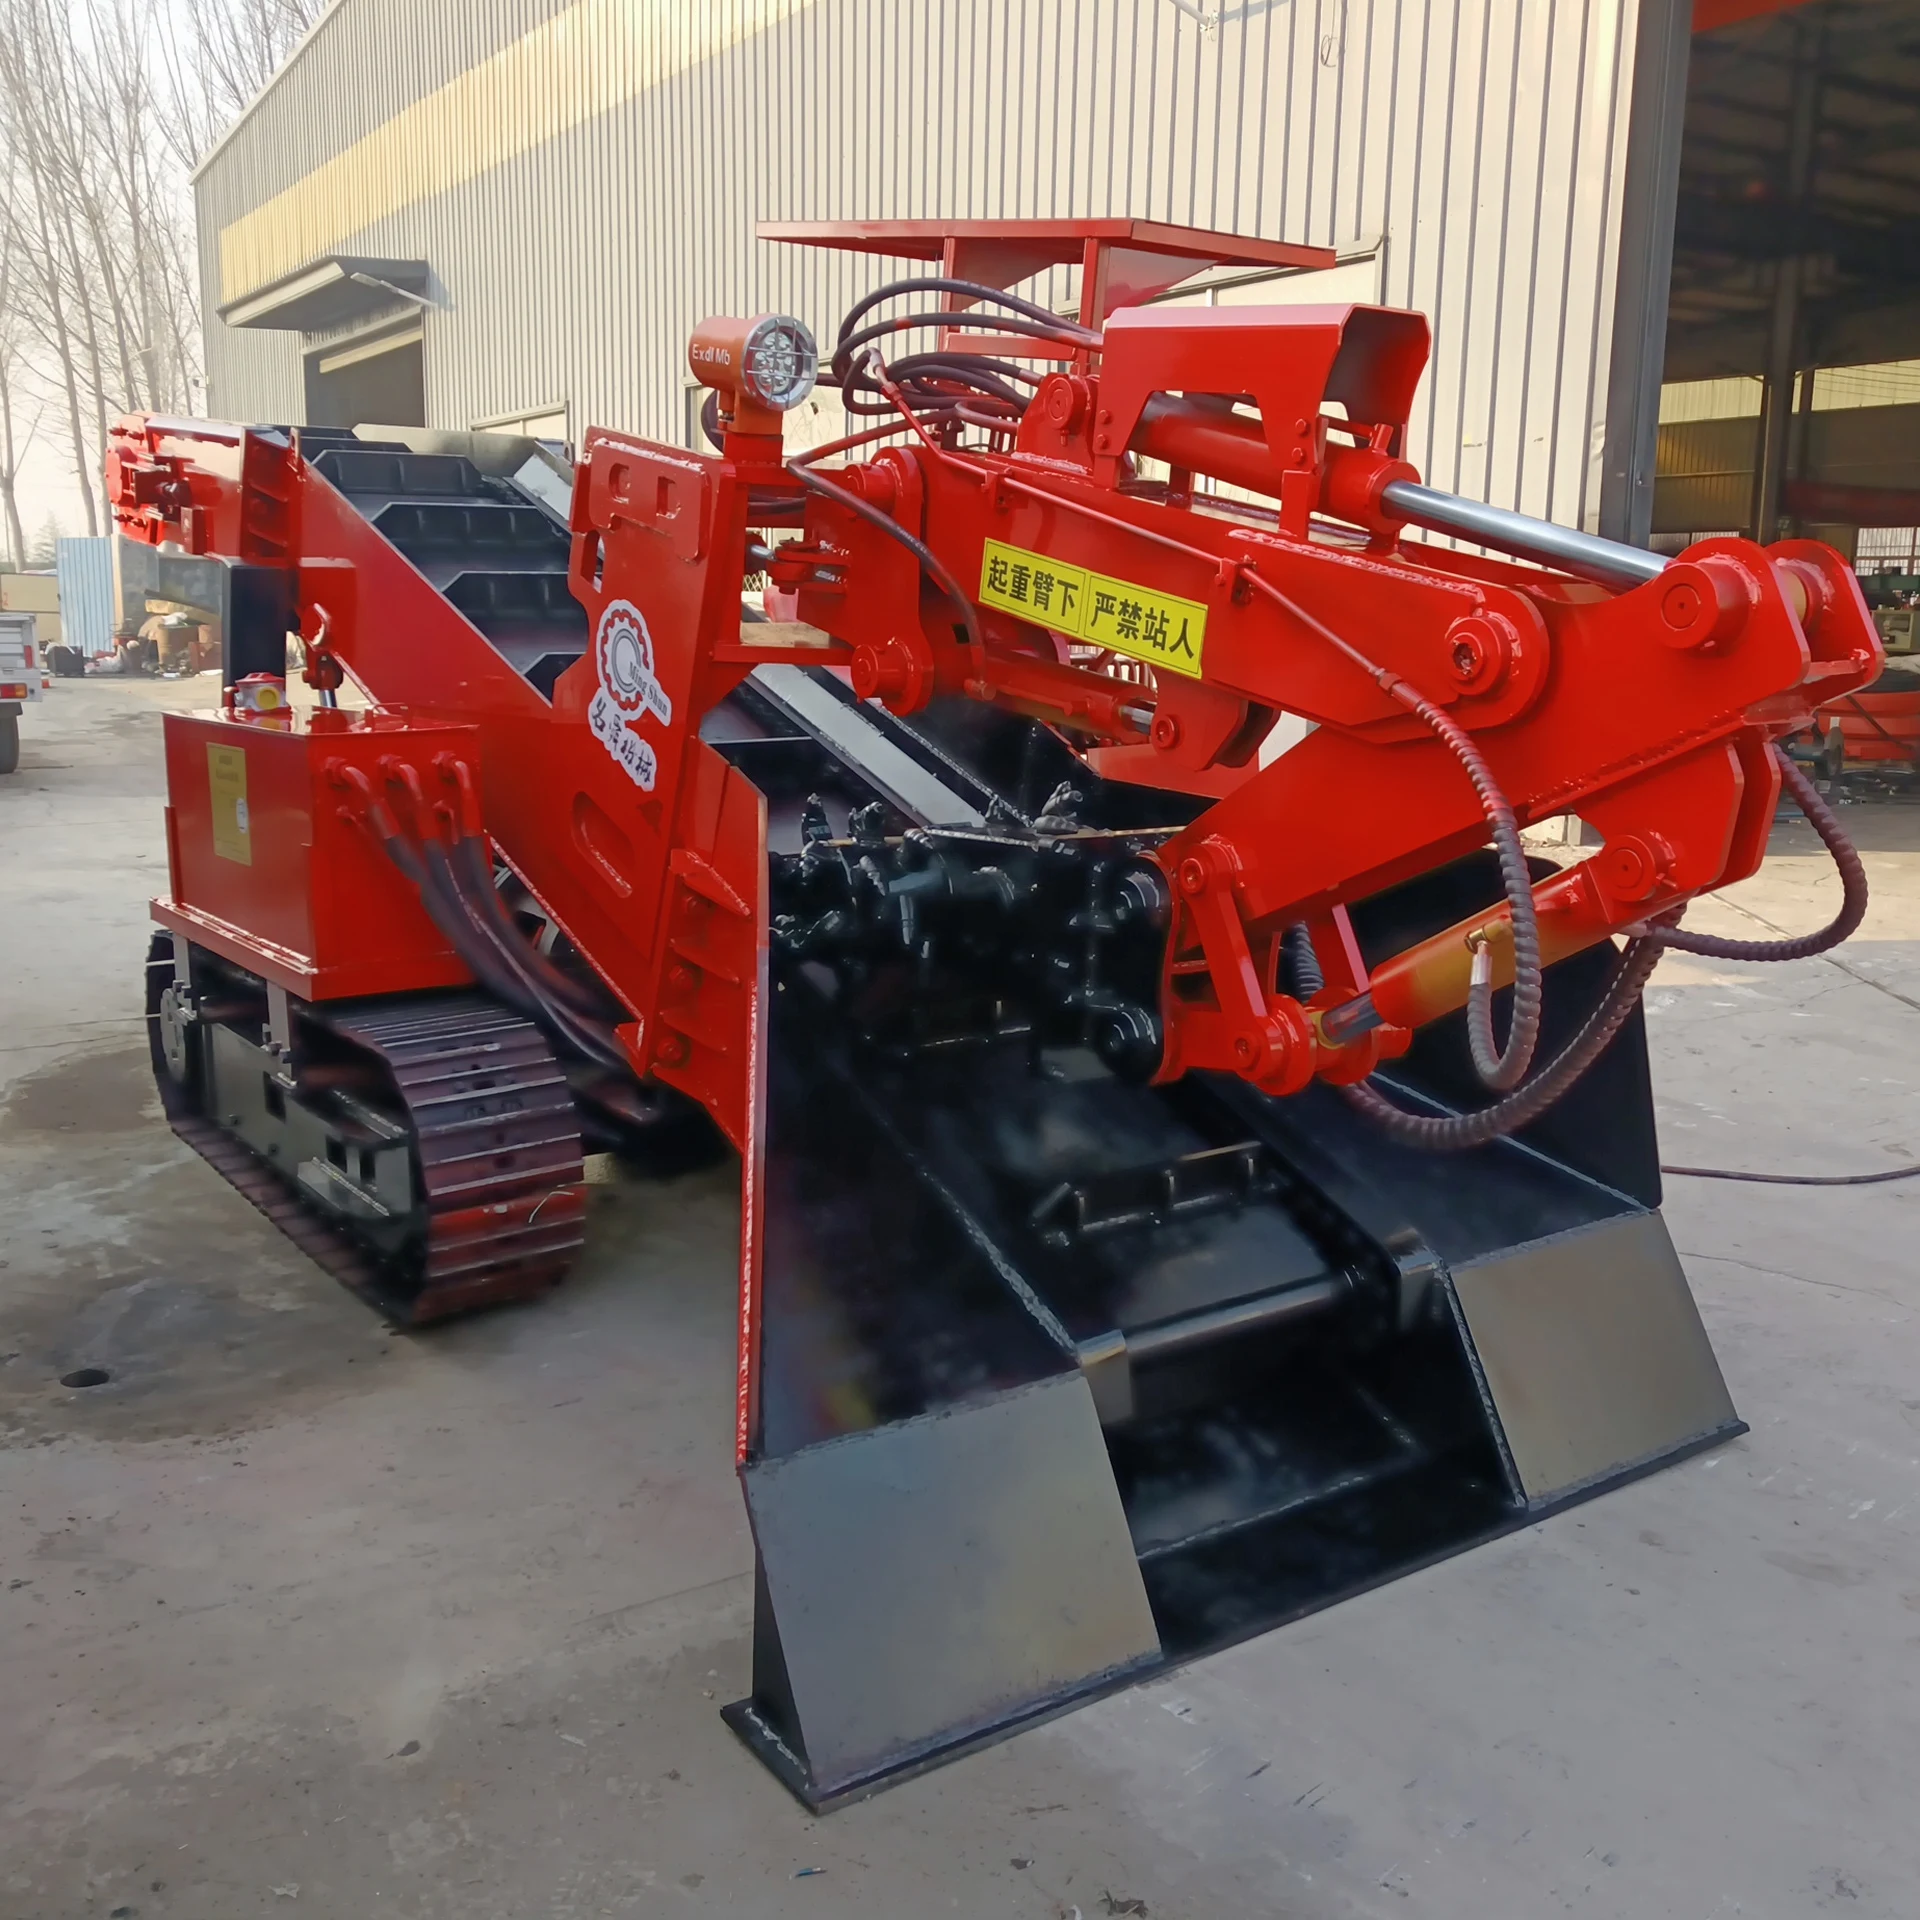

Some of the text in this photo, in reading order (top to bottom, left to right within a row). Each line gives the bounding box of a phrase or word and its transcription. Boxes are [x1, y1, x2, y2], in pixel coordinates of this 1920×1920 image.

[987, 555, 1195, 659] 起重臂下 严禁站人
[629, 661, 668, 717] Ming Shun
